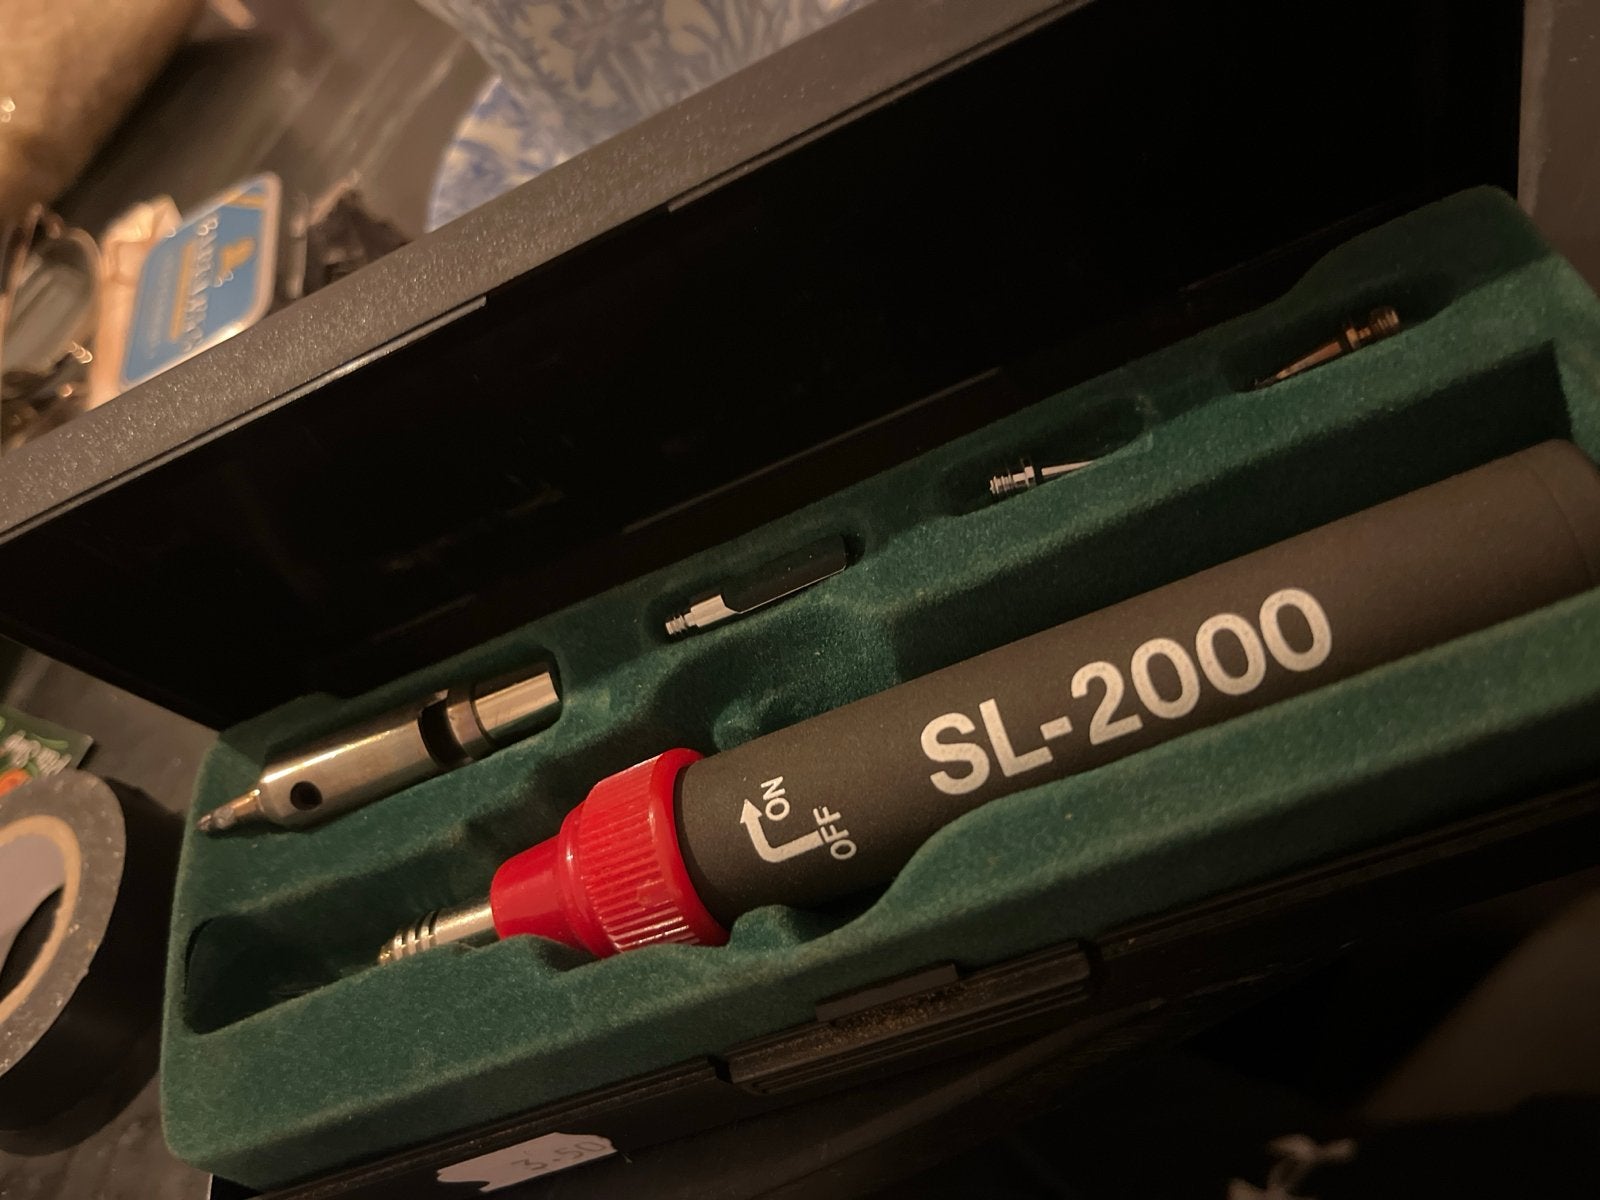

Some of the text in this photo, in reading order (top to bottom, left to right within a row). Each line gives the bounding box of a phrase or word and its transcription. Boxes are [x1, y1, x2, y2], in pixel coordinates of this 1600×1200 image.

[920, 587, 1333, 796] SL-2000
[760, 776, 791, 821] ON
[812, 805, 857, 861] OFF
[510, 1141, 607, 1171] 3.50
